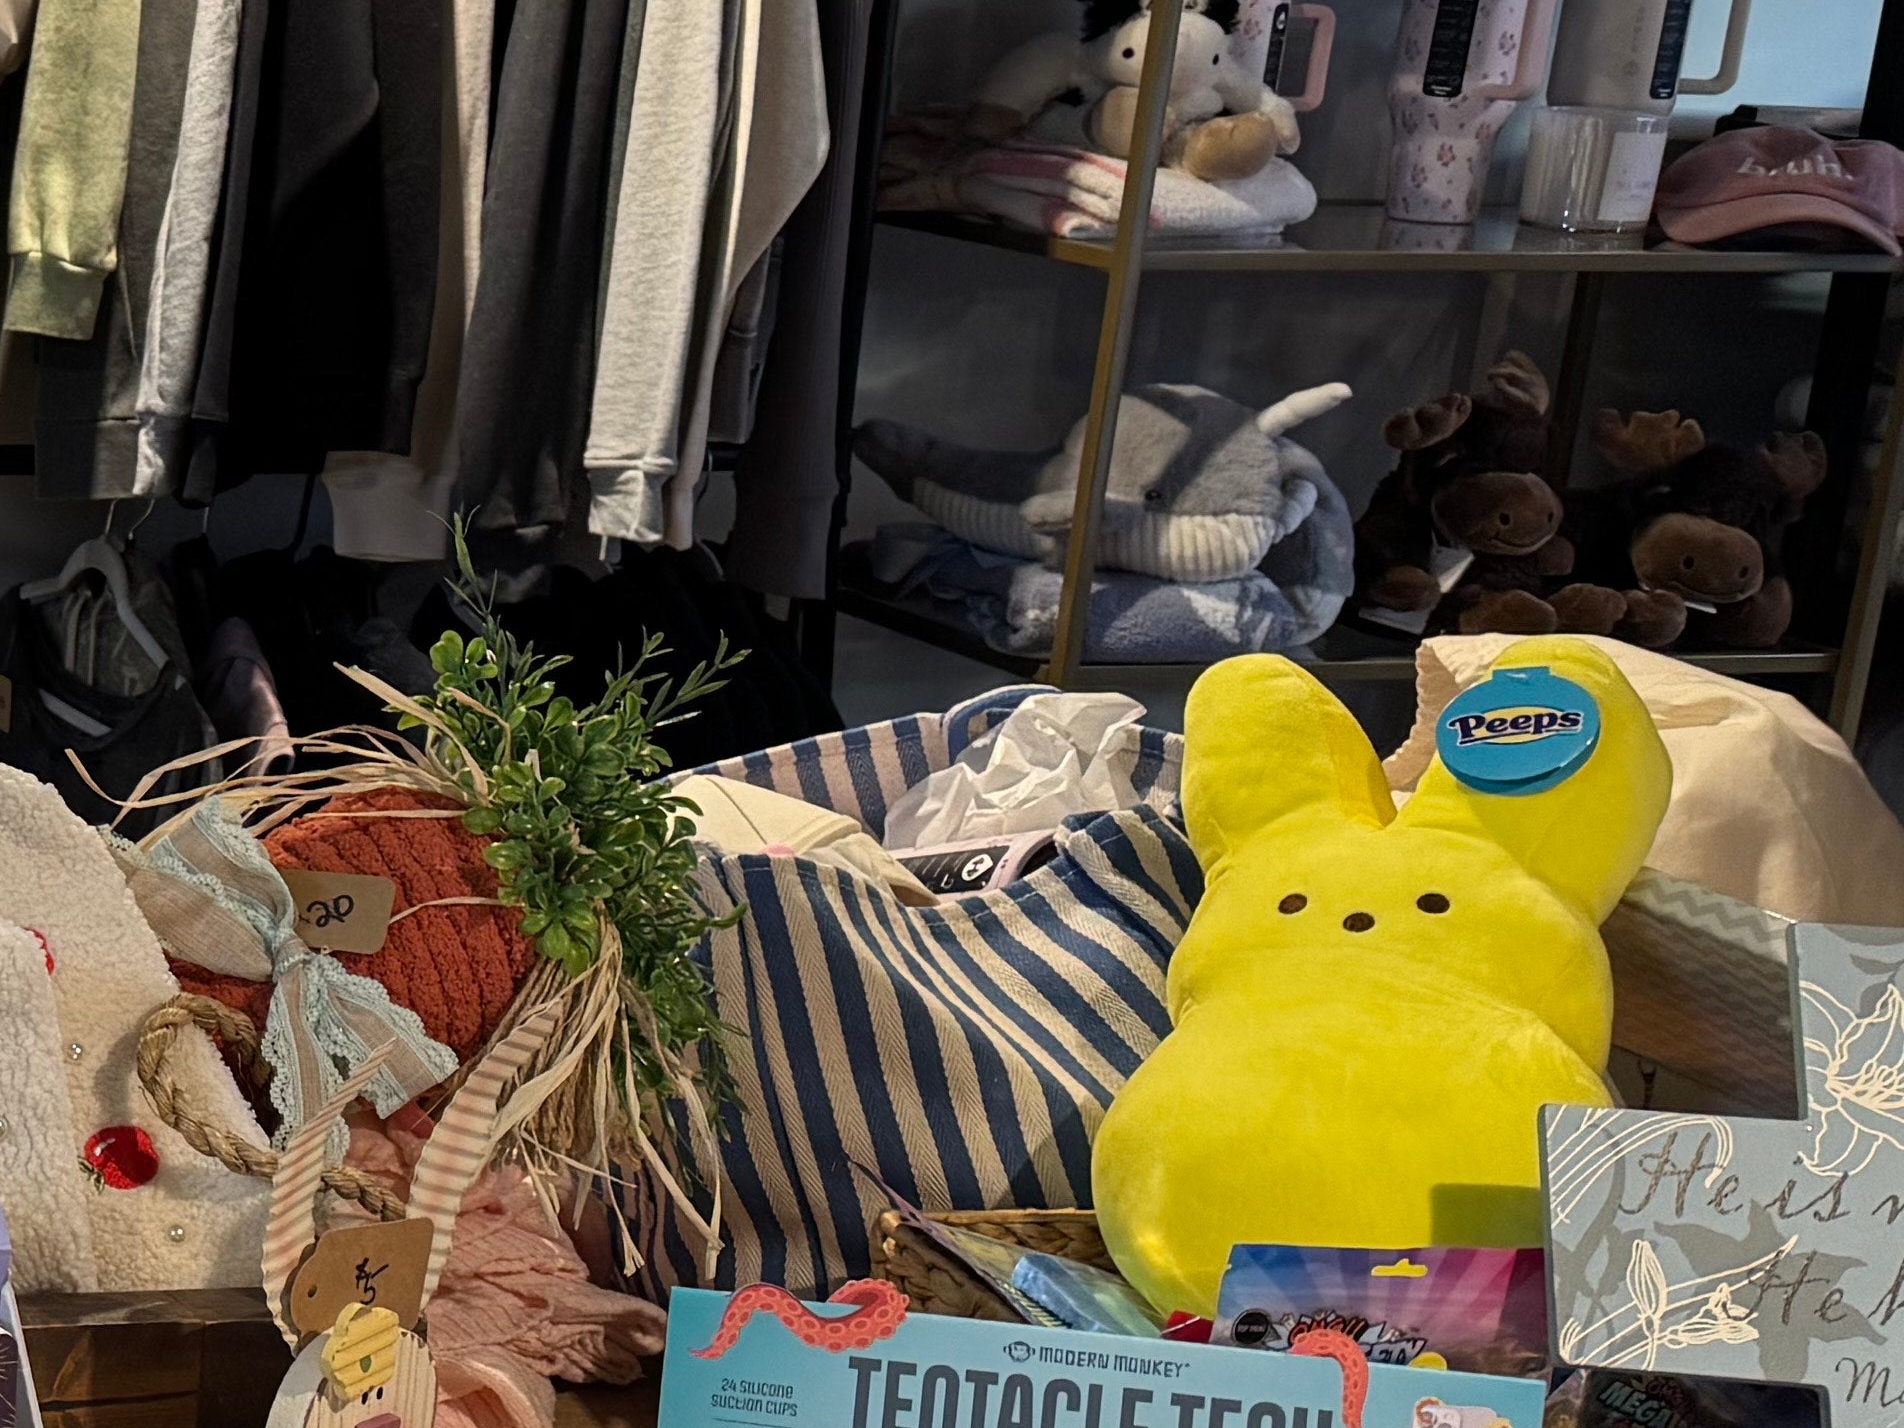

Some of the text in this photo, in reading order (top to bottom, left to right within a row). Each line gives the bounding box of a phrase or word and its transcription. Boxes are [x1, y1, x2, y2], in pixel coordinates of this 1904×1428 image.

[1448, 710, 1583, 744] Peeps
[1618, 1131, 1744, 1219] He
[1039, 1346, 1184, 1378] MODERN MONKEY
[721, 1378, 793, 1399] 24 SILICONE
[711, 1393, 798, 1418] SUCTION CUPS
